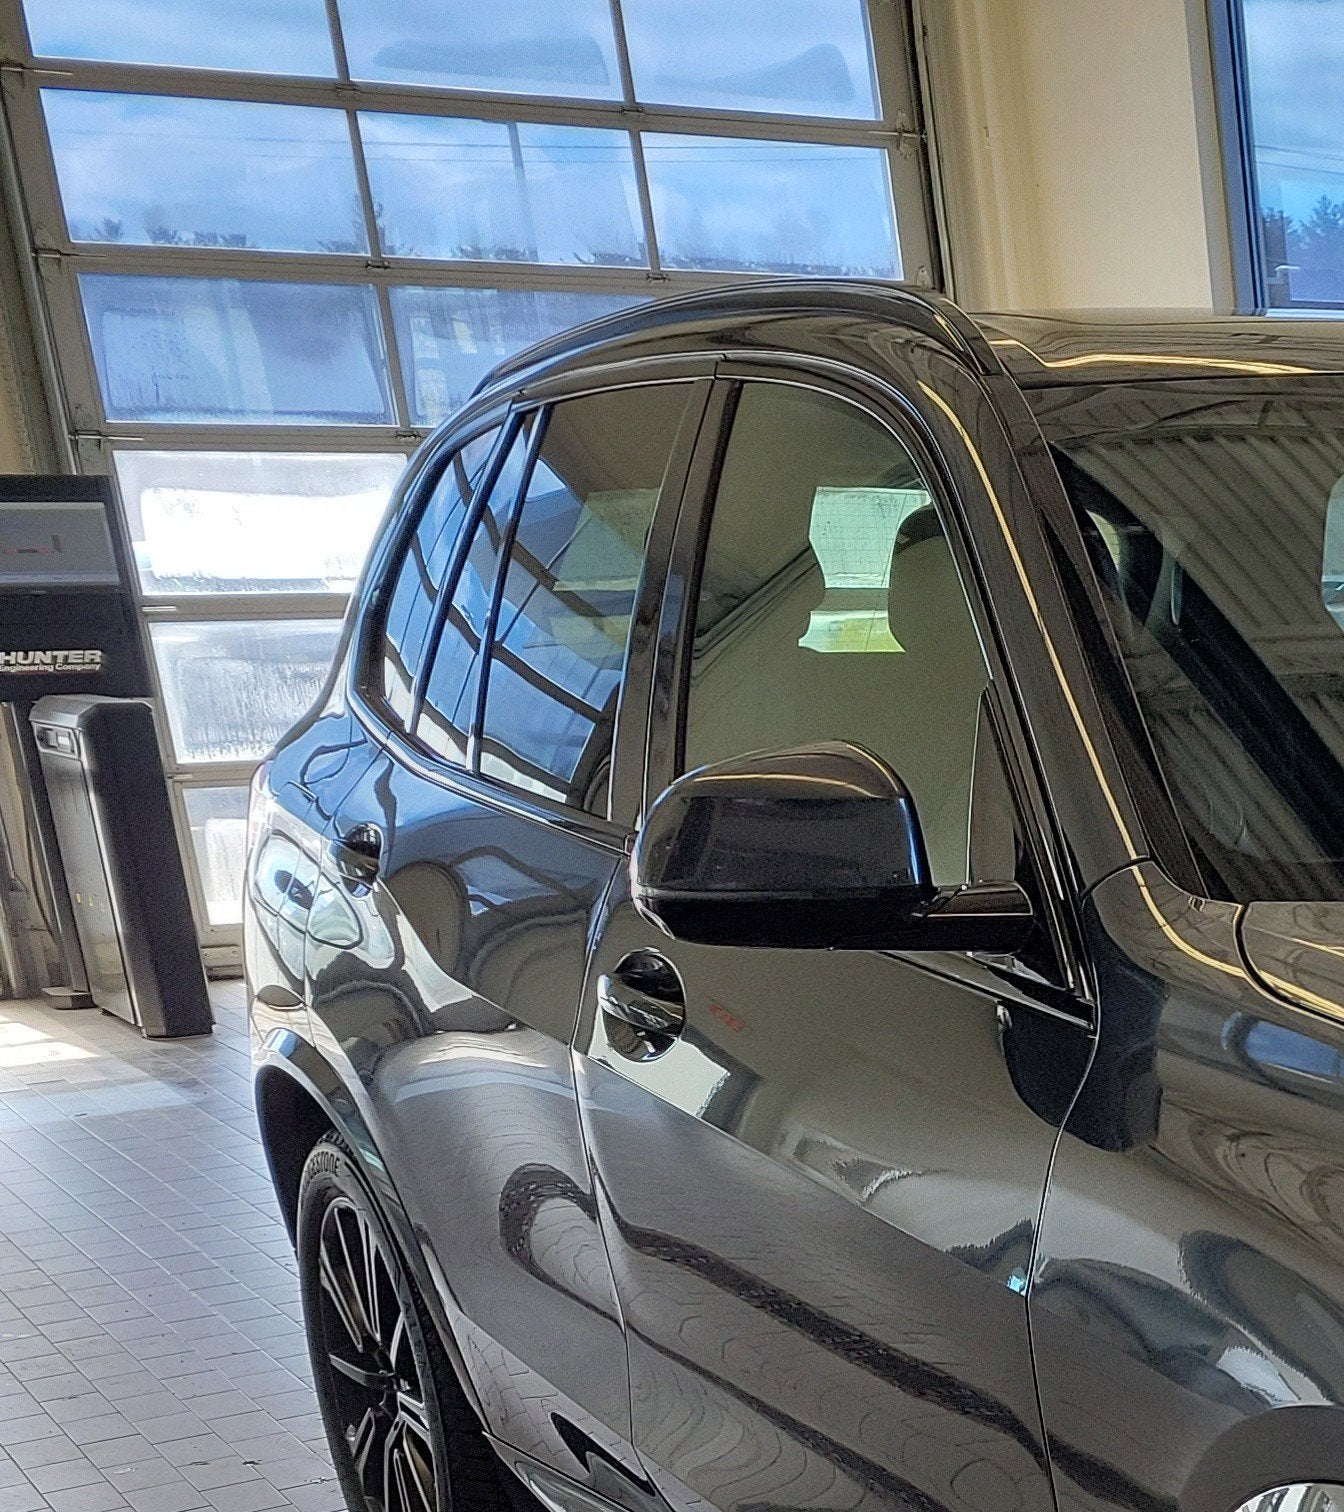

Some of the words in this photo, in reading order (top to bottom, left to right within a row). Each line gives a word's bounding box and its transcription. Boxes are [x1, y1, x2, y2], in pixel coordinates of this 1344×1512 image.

[0, 650, 102, 665] HUNTER
[0, 664, 54, 672] Engineering
[55, 663, 101, 671] Company
